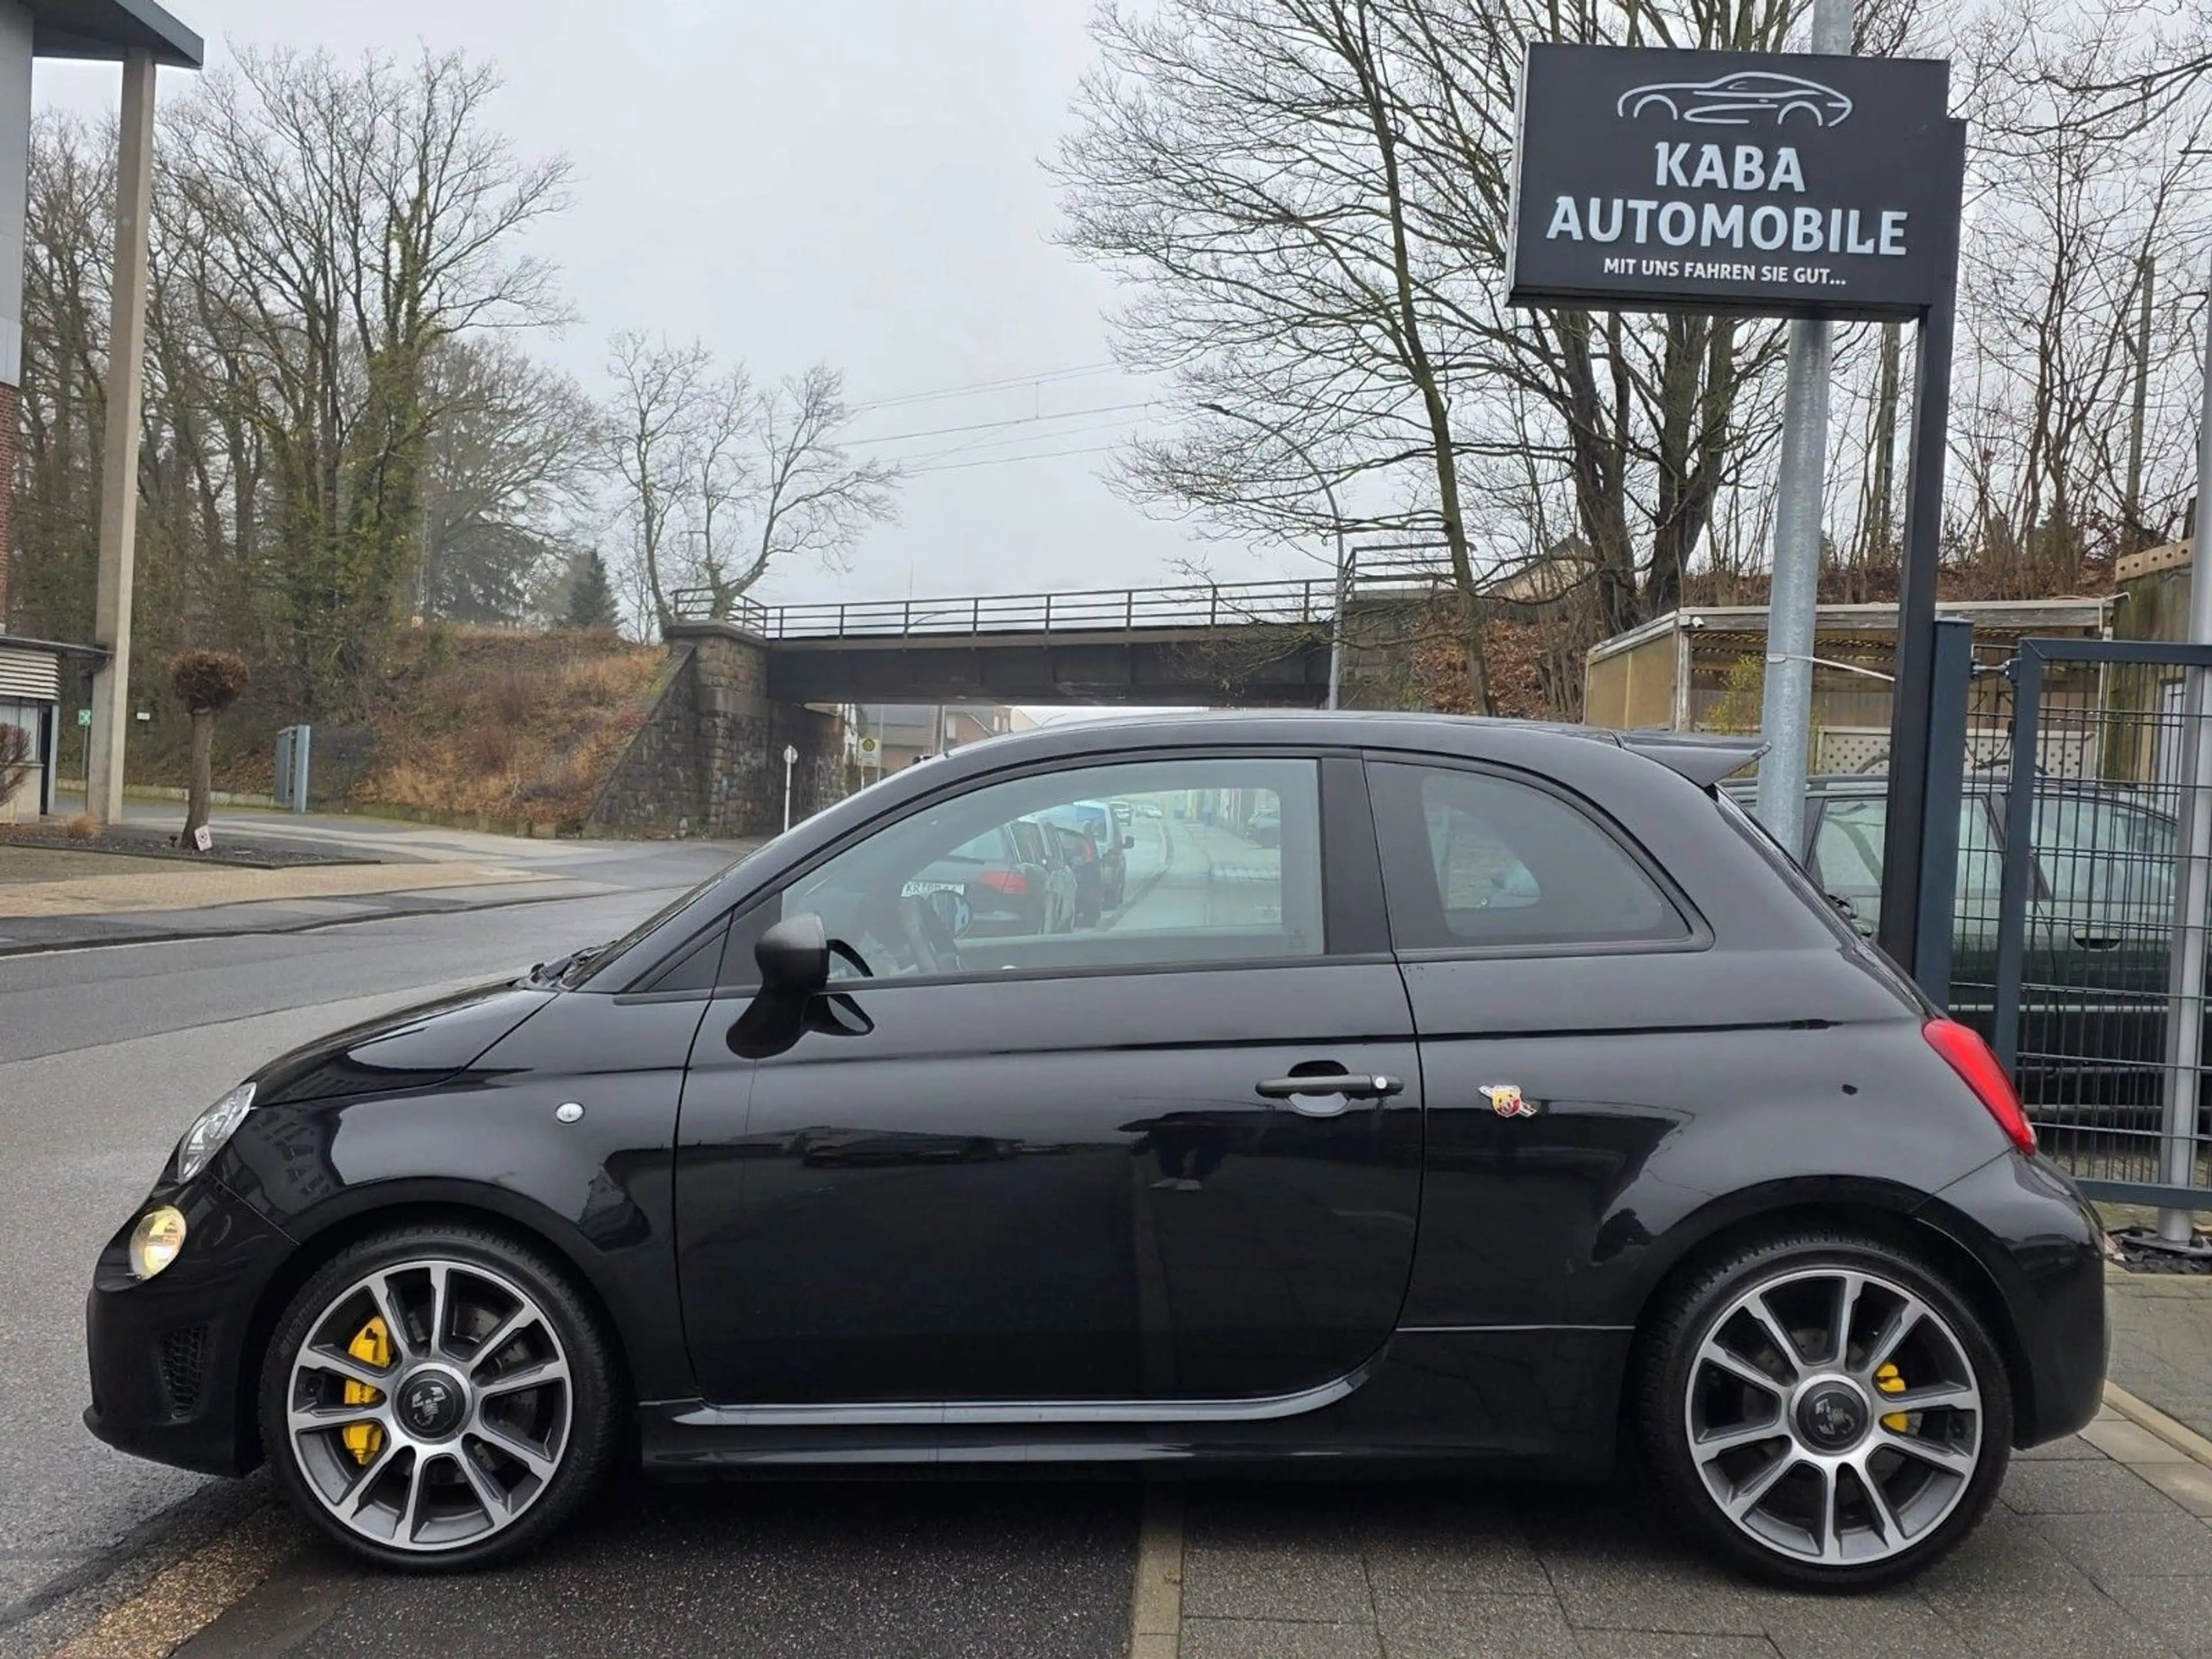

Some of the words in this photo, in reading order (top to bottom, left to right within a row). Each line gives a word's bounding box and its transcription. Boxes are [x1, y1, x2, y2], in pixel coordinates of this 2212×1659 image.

[1654, 141, 1806, 192] KABA
[1546, 195, 1908, 255] AUTOMOBILE
[1604, 257, 1637, 275] MIT
[1642, 259, 1679, 277] UNS
[1684, 262, 1756, 281] FAHREN
[1760, 266, 1789, 282] SIE
[1793, 267, 1847, 285] GUT...
